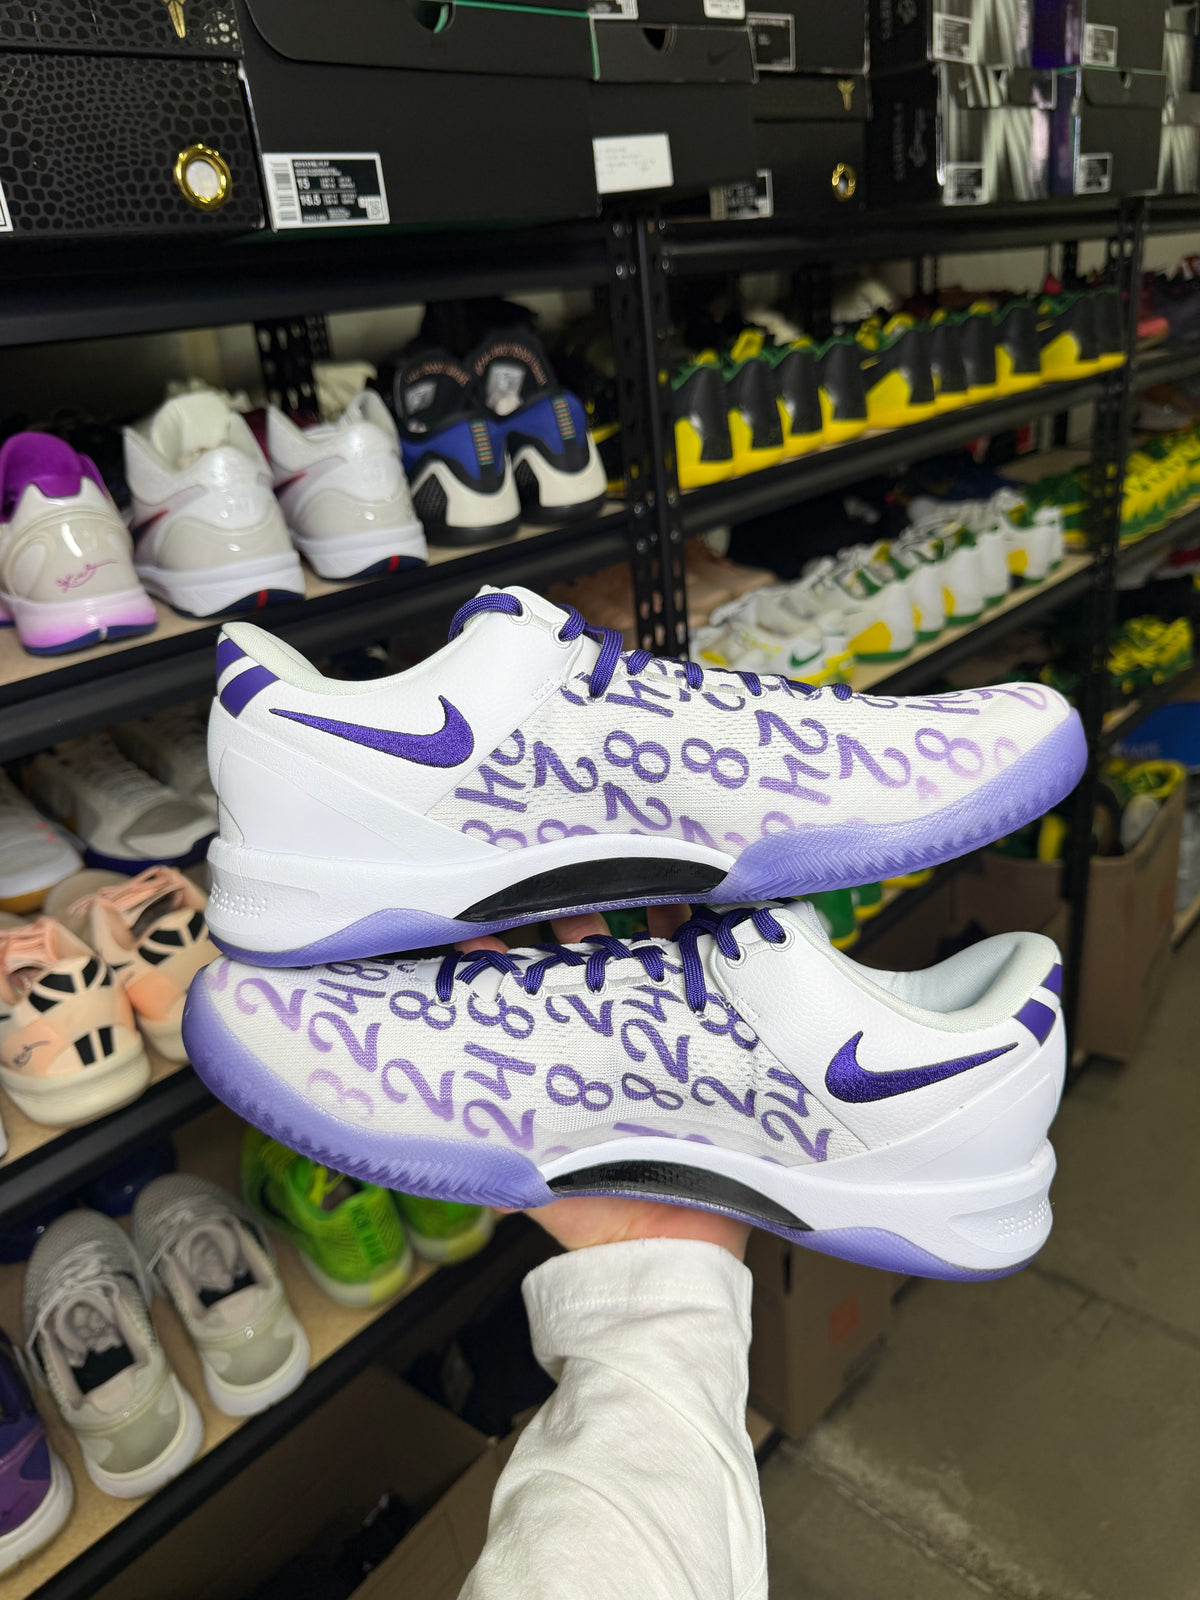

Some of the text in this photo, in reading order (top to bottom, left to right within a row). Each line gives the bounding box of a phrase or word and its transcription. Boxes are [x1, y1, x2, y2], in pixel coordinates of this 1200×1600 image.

[532, 740, 599, 794] 2
[603, 730, 671, 784] 8
[681, 738, 750, 790] 8
[836, 733, 912, 789] 2
[914, 727, 985, 780] 8
[602, 781, 673, 832] 2
[234, 977, 307, 1032] 2
[389, 989, 456, 1031] 8
[380, 1057, 455, 1122] 2
[545, 1063, 614, 1112] 8
[690, 1075, 758, 1118] 2
